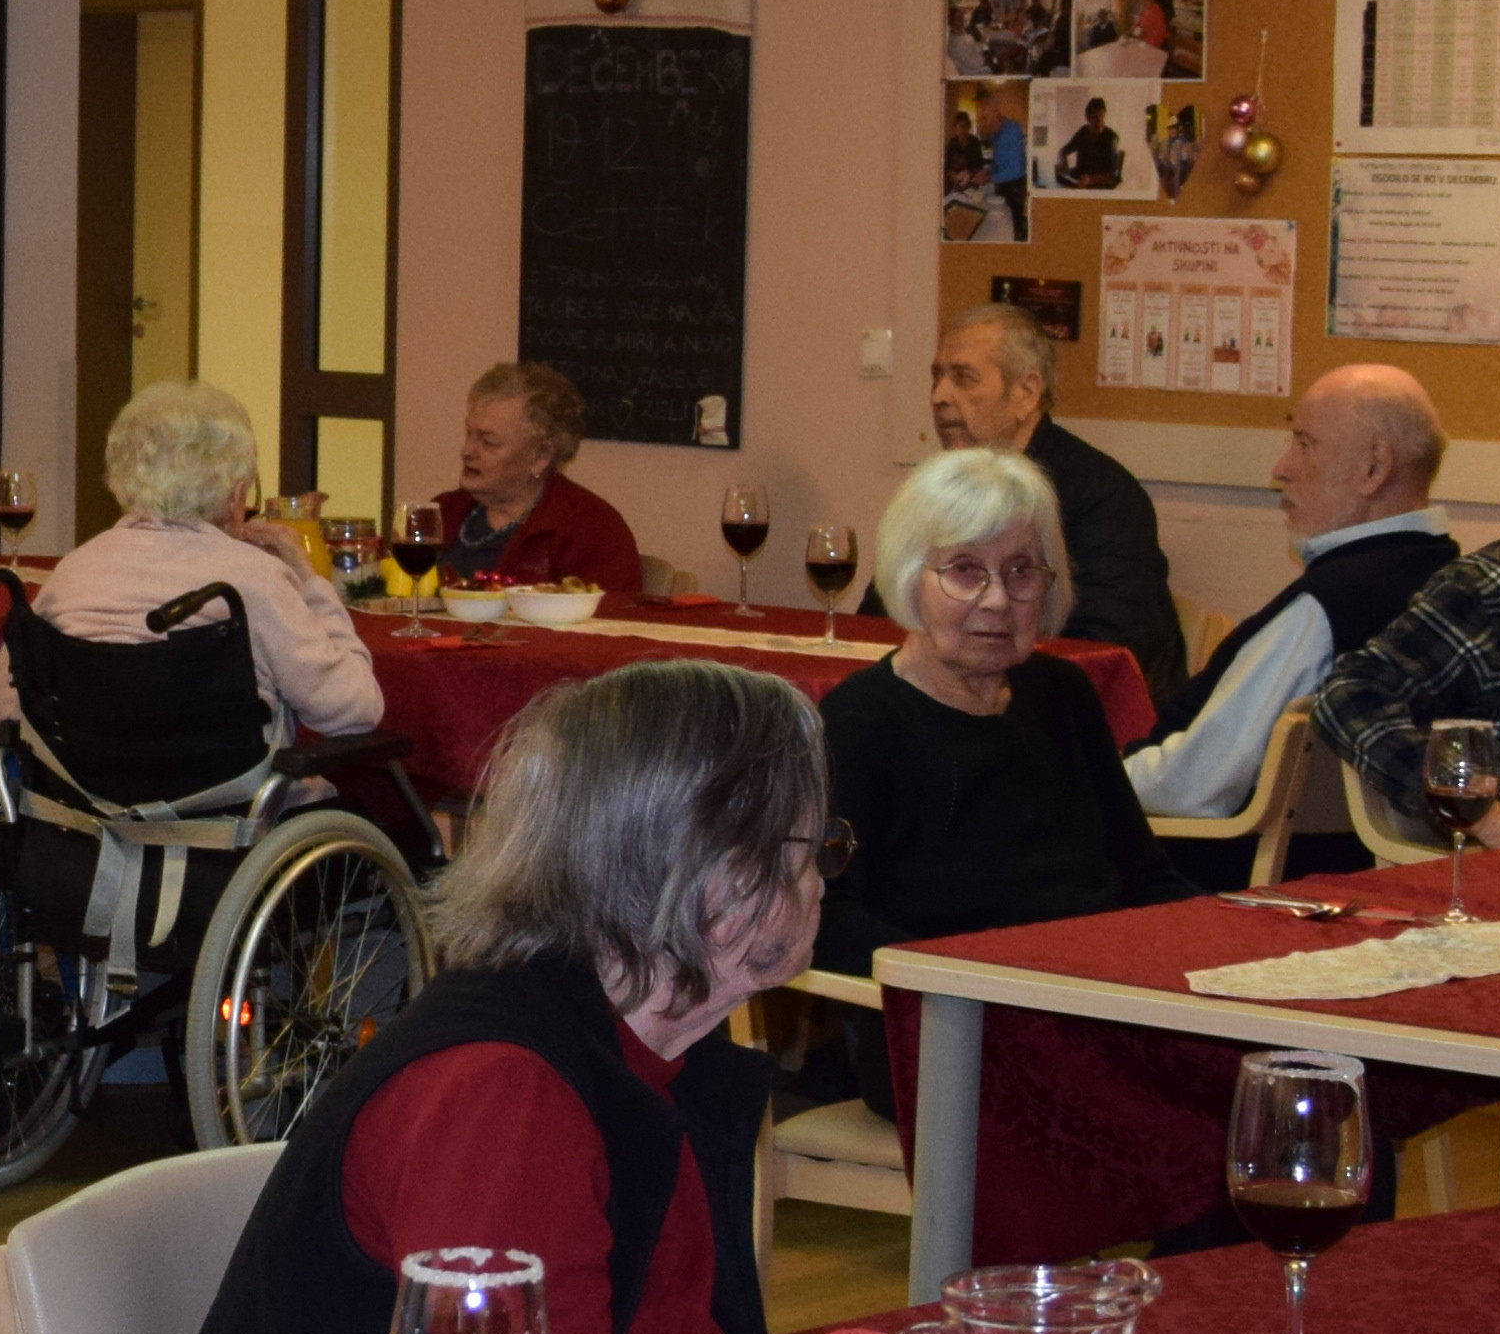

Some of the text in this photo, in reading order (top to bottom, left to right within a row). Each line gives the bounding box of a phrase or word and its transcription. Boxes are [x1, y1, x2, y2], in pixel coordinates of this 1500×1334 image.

[535, 43, 726, 97] DECEMBER
[1152, 240, 1241, 255] AKTIVNOSTI NA
[1171, 258, 1219, 273] SKUPINI
